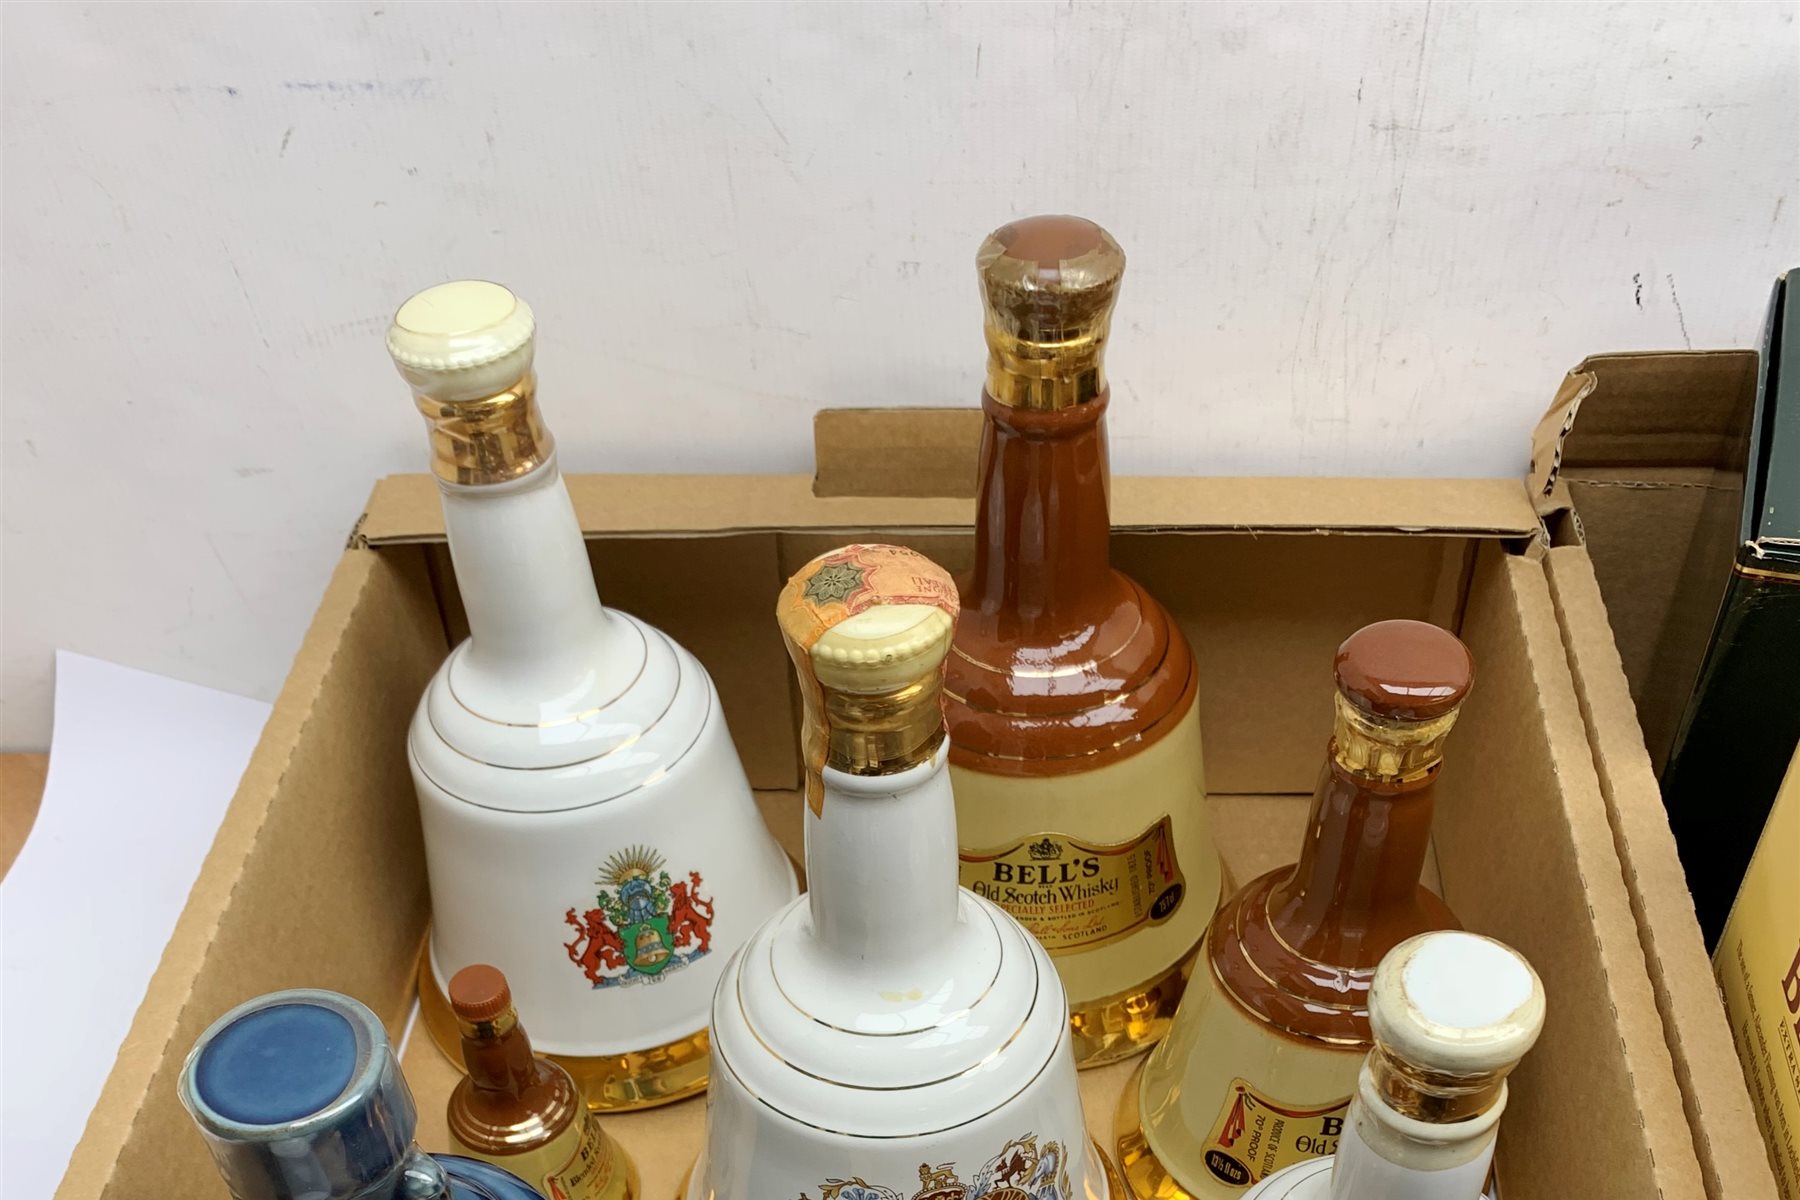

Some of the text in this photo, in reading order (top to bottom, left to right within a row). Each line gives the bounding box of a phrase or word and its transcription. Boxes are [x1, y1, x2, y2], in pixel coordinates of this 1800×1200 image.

[993, 857, 1100, 886] BELL'S
[972, 877, 1119, 905] Old Scotch Whisky
[1001, 900, 1095, 915] PECIALLY SELECTED
[1063, 925, 1108, 940] SCOTLAND
[1247, 1127, 1262, 1163] PROOF
[1296, 1136, 1326, 1155] Old
